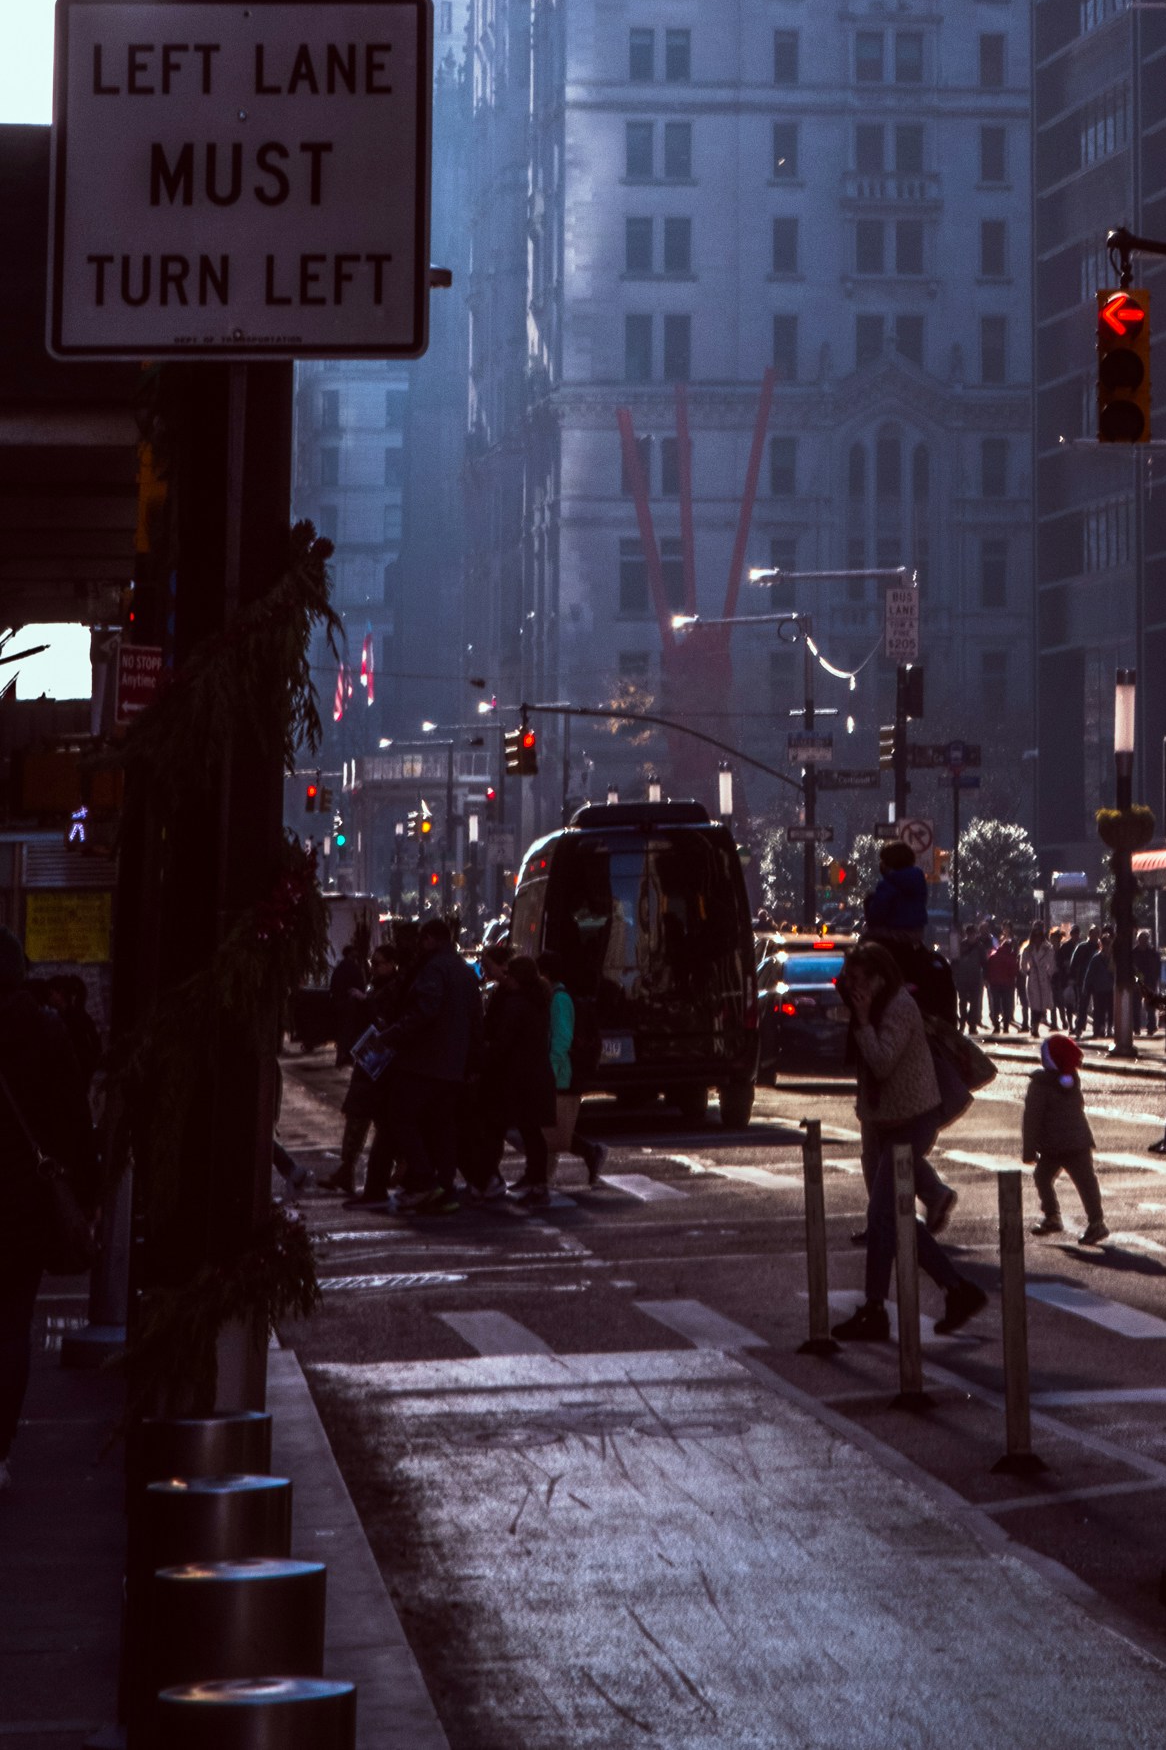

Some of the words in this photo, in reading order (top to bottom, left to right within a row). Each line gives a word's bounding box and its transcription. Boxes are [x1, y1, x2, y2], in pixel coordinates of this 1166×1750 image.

[93, 44, 221, 95] LEFT
[254, 44, 393, 94] LANE
[150, 141, 334, 206] MUST
[87, 254, 230, 306] TURN
[265, 254, 393, 305] LEFT
[203, 336, 214, 345] OF
[892, 592, 913, 603] BUS
[888, 604, 916, 616] LANE
[121, 654, 135, 669] NO
[121, 671, 157, 690] Anytime
